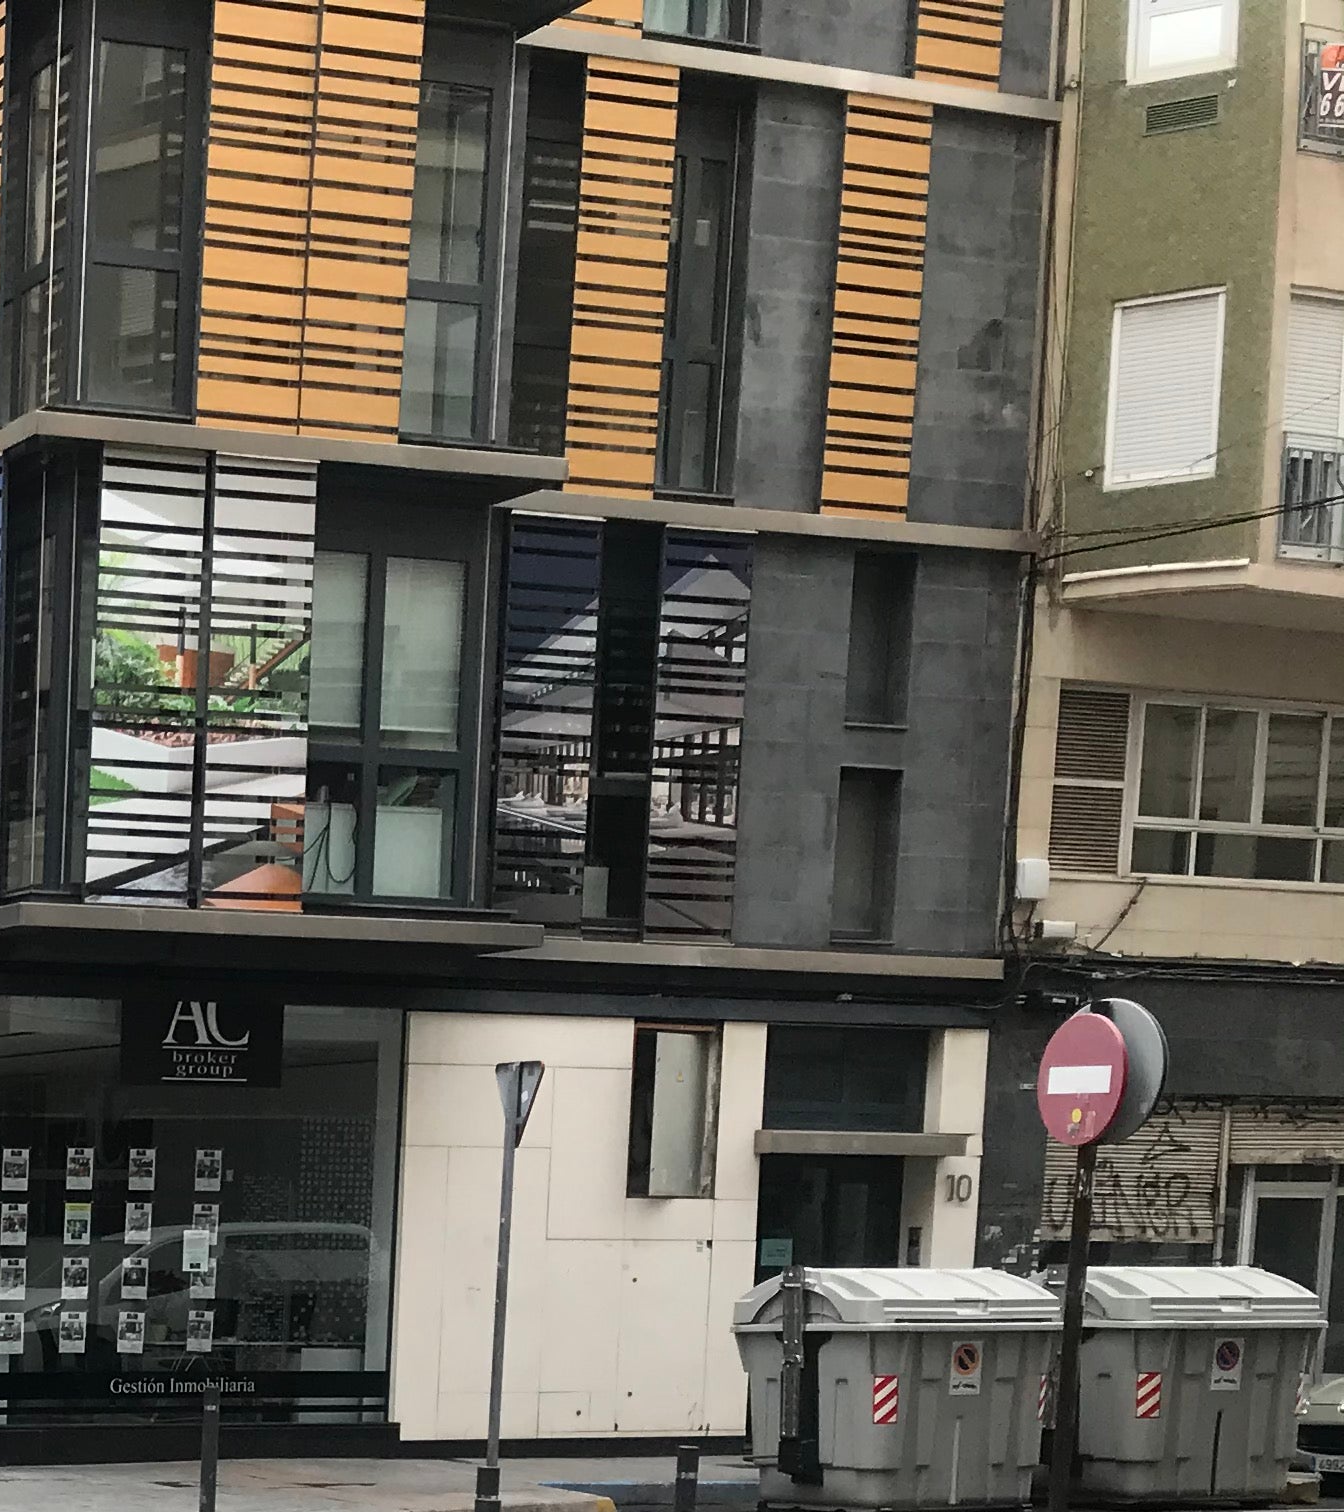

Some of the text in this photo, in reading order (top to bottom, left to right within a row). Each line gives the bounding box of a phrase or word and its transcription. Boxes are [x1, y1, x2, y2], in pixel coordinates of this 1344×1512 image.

[172, 1051, 238, 1064] broker
[175, 1064, 234, 1078] group
[946, 1174, 973, 1203] 10
[109, 1377, 165, 1394] Gestión
